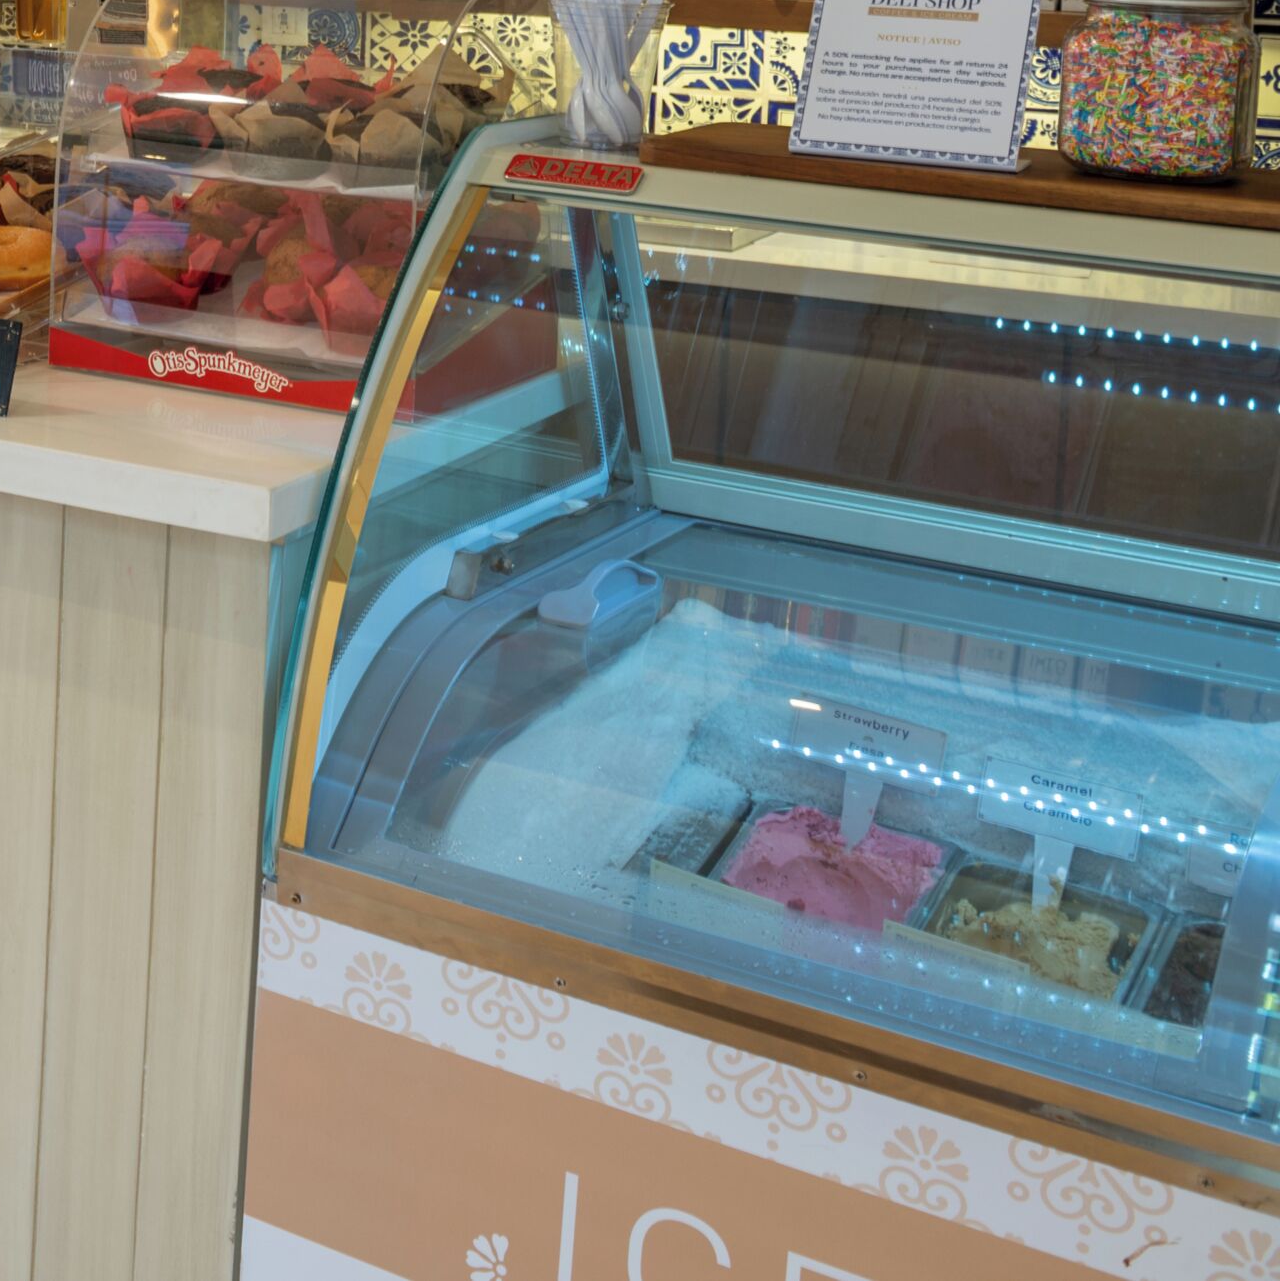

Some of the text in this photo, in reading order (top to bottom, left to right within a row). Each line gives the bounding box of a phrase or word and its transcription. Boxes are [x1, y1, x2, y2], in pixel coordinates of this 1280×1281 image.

[877, 33, 961, 46] NOTICE AVISO
[851, 53, 891, 62] restocking
[966, 61, 995, 69] returns
[543, 160, 635, 183] DELTA
[1030, 773, 1094, 799] Caramel
[1022, 801, 1094, 828] Caramelo
